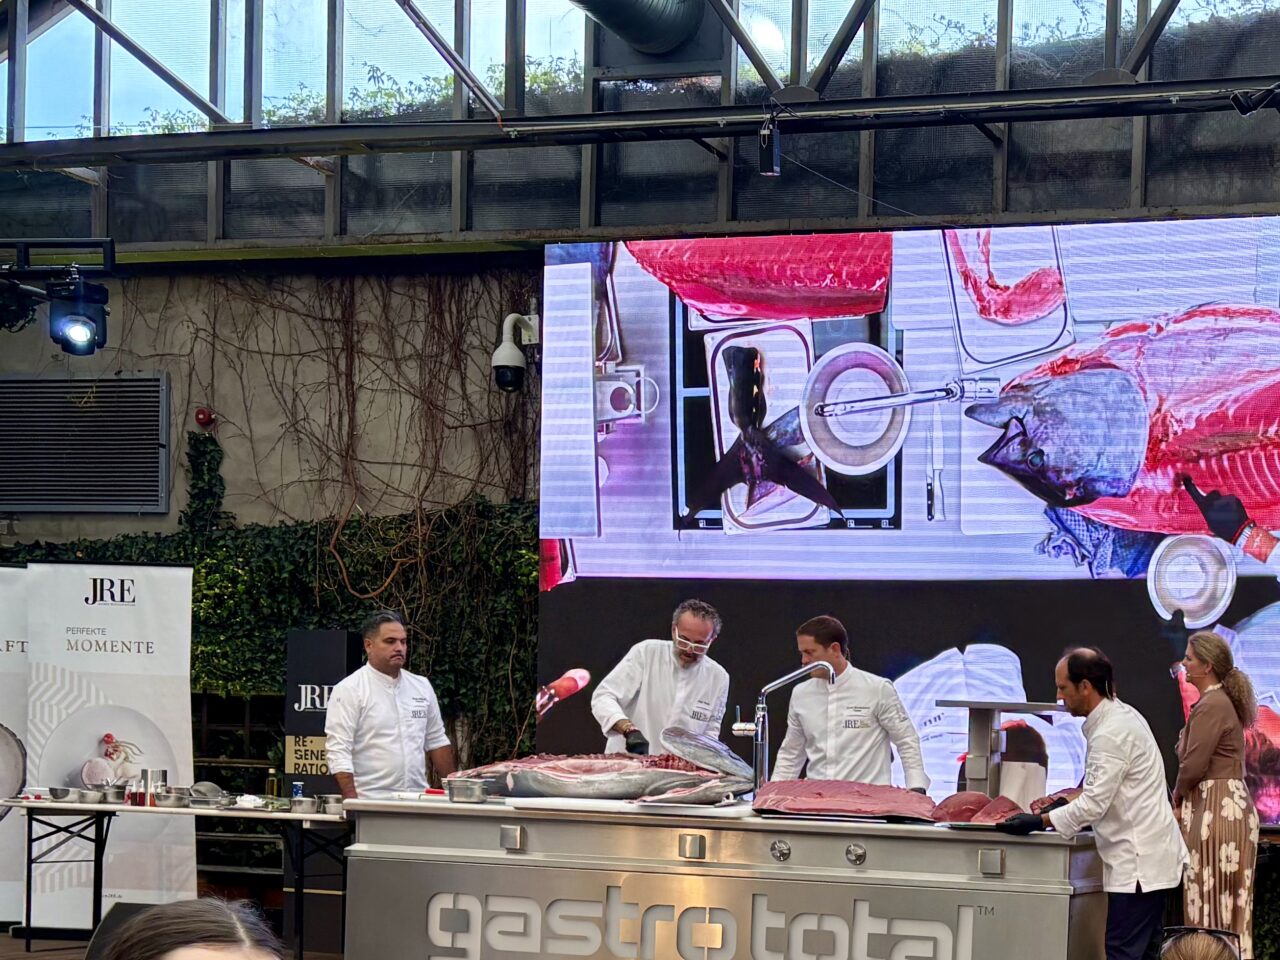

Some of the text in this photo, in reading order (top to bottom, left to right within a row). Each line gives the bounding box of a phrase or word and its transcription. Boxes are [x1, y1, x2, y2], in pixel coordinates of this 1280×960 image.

[84, 577, 136, 605] JRE
[66, 627, 107, 636] PERFEKTE
[0, 640, 29, 653] FT
[66, 638, 155, 654] MOMENTE
[294, 749, 326, 761] GENE
[293, 763, 329, 775] RATIO
